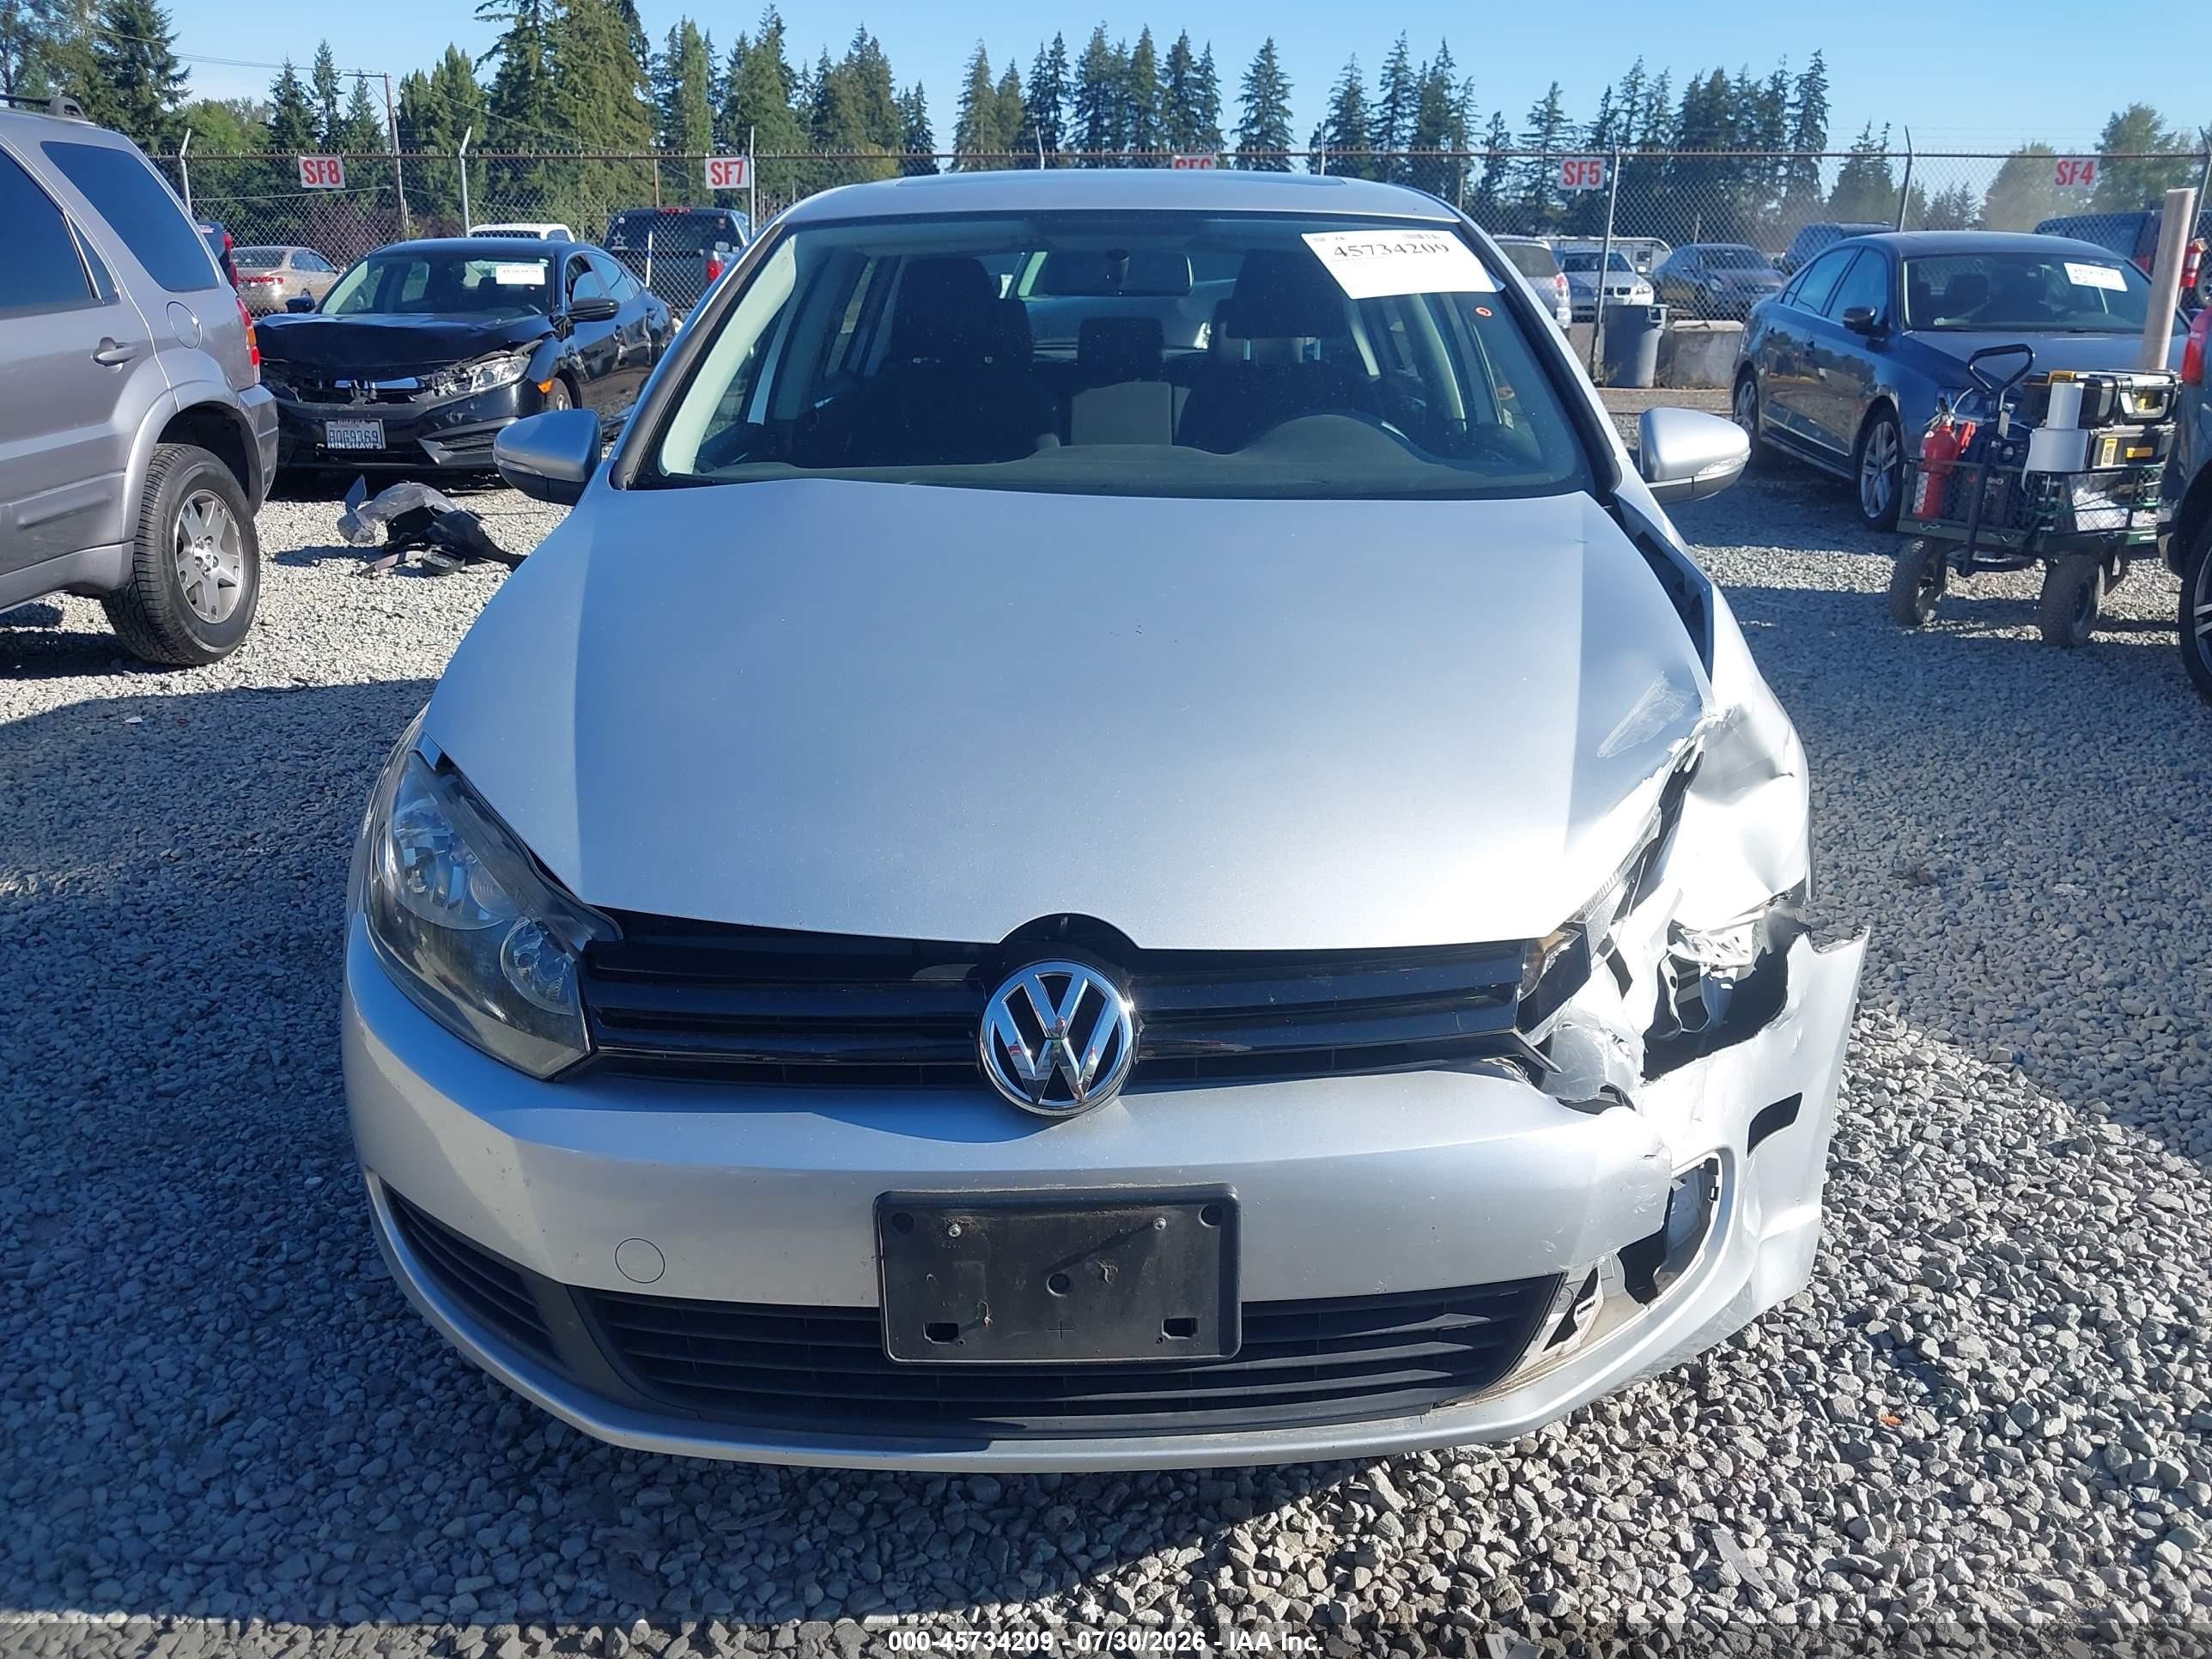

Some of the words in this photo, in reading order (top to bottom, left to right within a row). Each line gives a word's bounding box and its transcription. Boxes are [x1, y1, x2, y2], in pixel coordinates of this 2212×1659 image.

[302, 160, 341, 185] SF8
[710, 161, 744, 186] SF7
[1563, 161, 1601, 186] SF5
[2054, 161, 2094, 185] SF4
[1334, 243, 1449, 257] 45734209
